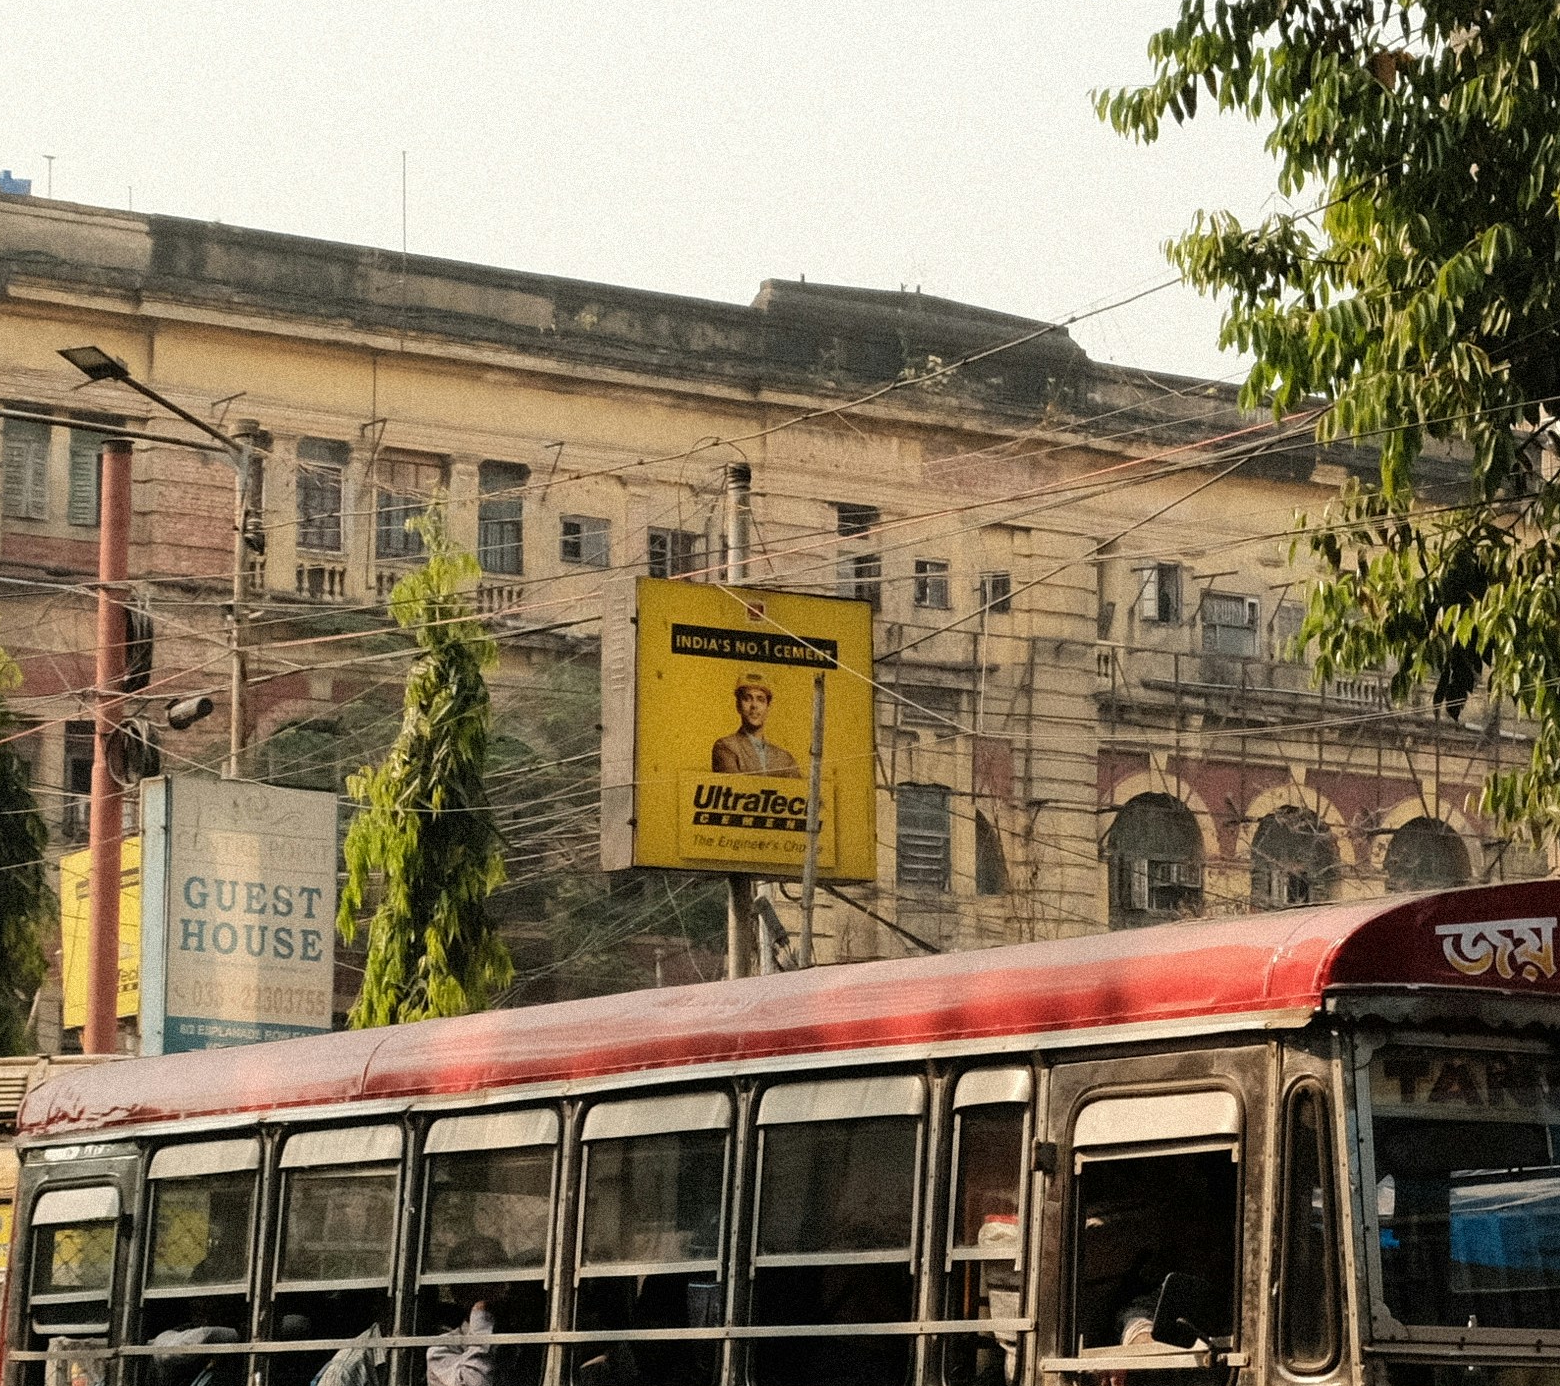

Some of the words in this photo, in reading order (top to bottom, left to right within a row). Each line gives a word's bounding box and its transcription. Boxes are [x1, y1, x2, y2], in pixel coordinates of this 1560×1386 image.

[675, 633, 731, 653] INDIA'S
[735, 639, 770, 657] NO.1
[773, 646, 833, 663] CEMENT
[693, 784, 822, 818] UltraTec
[698, 813, 798, 829] CEMEN
[268, 839, 332, 868] POINT
[182, 876, 322, 919] GUEST
[180, 918, 324, 962] HOUSE
[1435, 915, 1557, 983] জয়
